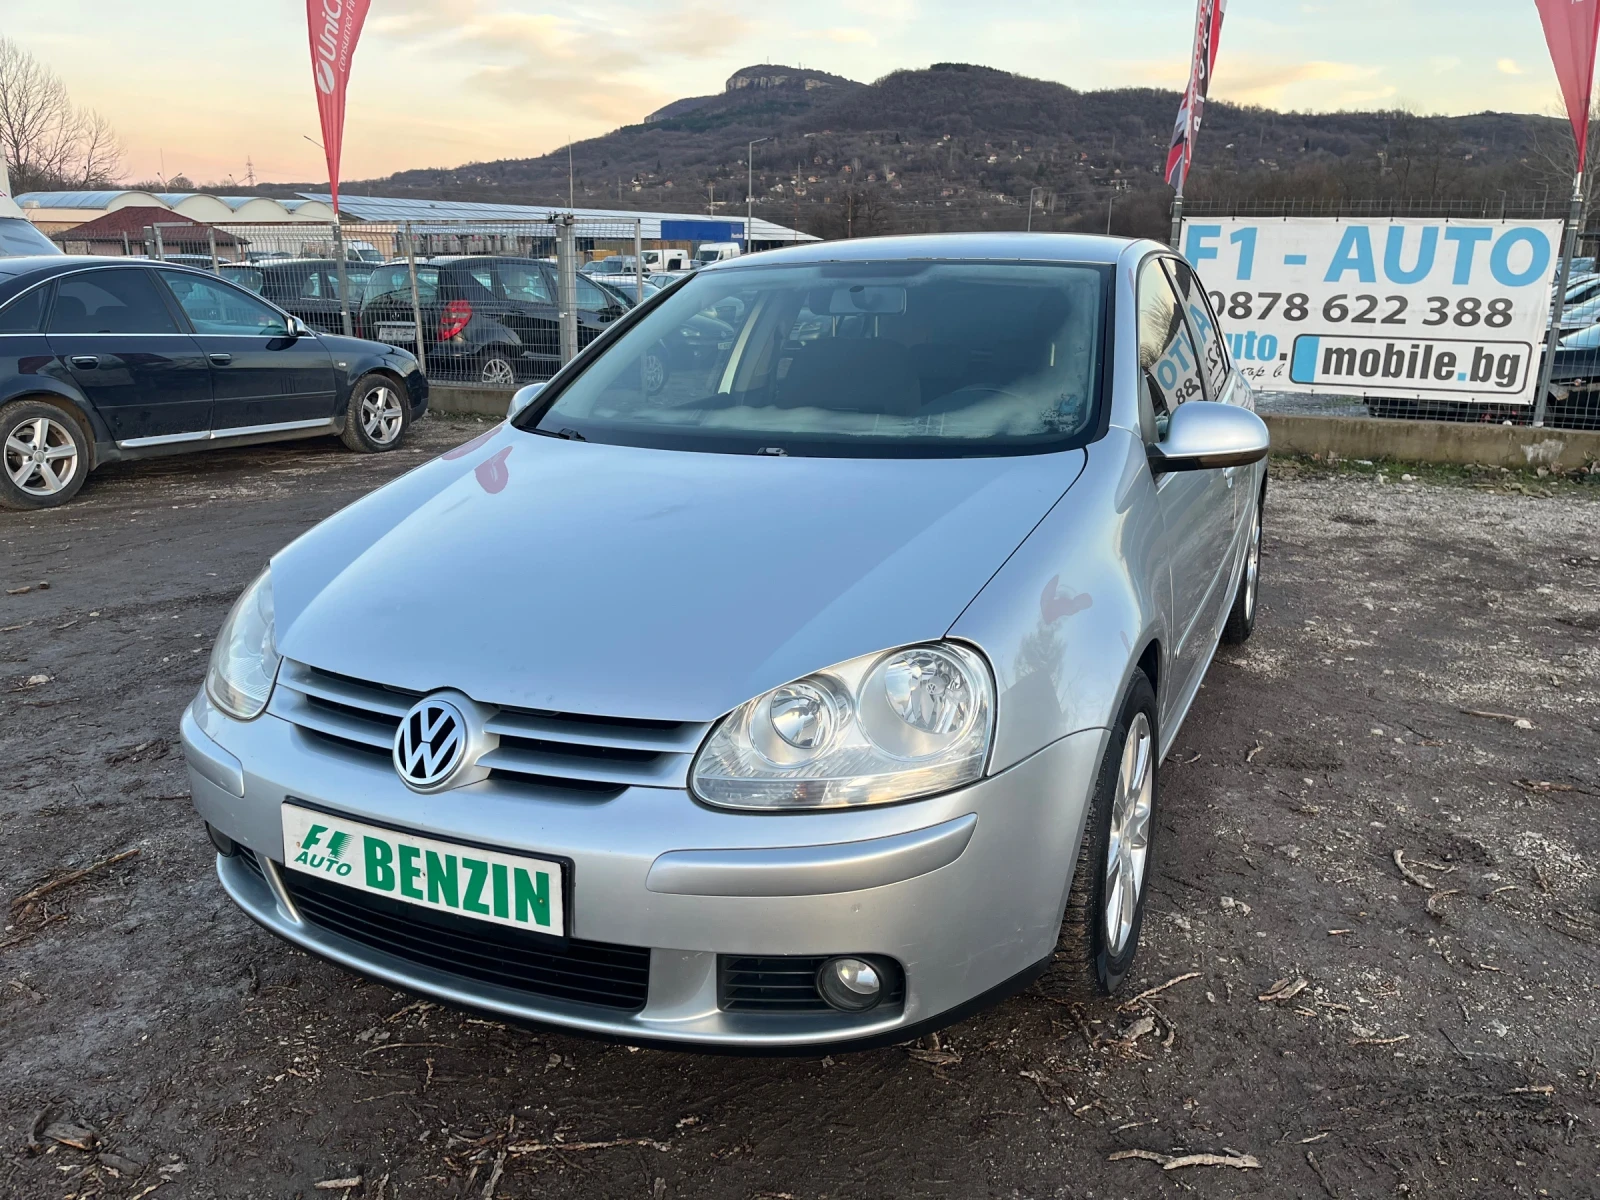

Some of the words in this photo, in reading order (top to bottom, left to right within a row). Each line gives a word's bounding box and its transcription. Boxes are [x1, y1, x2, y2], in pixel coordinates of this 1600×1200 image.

[318, 0, 342, 61] UniC
[339, 12, 353, 72] Consumer
[1186, 224, 1258, 281] F1
[1323, 225, 1551, 288] AUTO
[1207, 291, 1309, 321] 0878
[1322, 293, 1407, 325] 622
[1422, 297, 1513, 328] 388
[1321, 343, 1521, 388] mobile.bg
[294, 851, 352, 877] AUTO
[301, 824, 352, 861] F1
[363, 835, 551, 927] BENZIN
